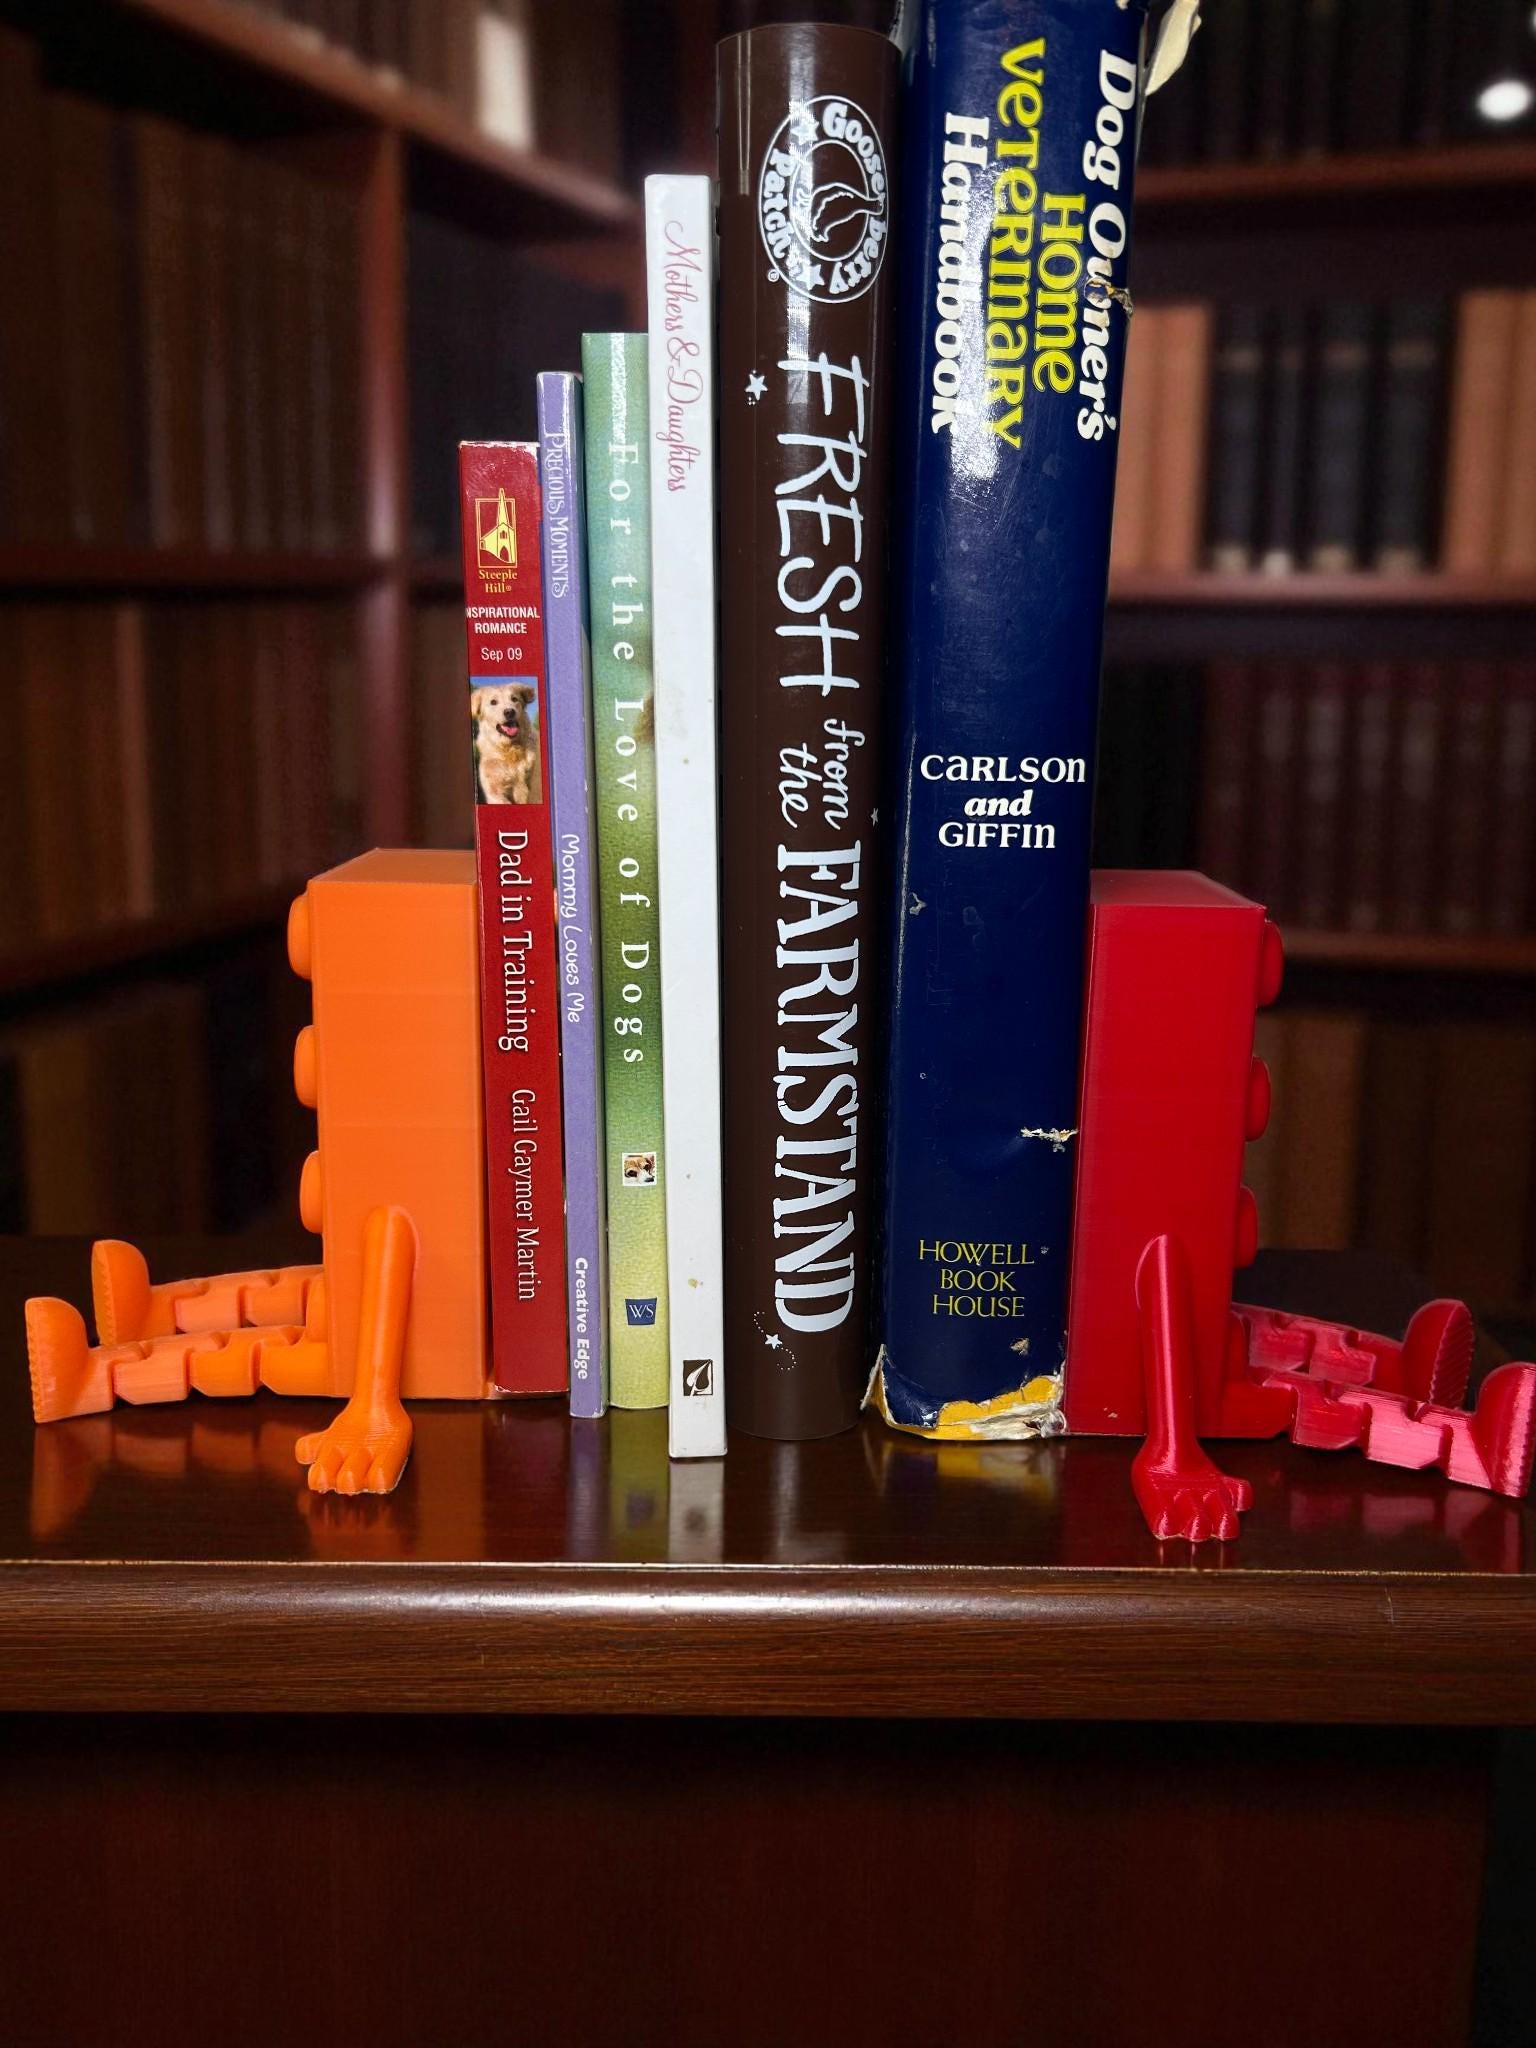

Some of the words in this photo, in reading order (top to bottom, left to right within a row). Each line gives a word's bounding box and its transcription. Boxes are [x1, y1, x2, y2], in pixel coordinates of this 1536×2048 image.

[1082, 49, 1138, 190] Dog
[664, 220, 703, 333] Mothers
[667, 336, 704, 367] &
[656, 366, 704, 493] Daughters
[608, 441, 639, 535] For
[775, 352, 870, 697] FRESH
[478, 569, 518, 583] Steeple
[549, 516, 569, 599] MOMENTS
[474, 622, 528, 634] ROMANCE
[481, 647, 504, 663] Sep
[507, 647, 523, 661] 09
[612, 574, 645, 661] the
[614, 697, 645, 822] Love
[778, 742, 823, 830] the
[823, 718, 866, 831] from
[963, 788, 1035, 817] and
[498, 830, 532, 887] Dad
[560, 833, 581, 919] Mommy
[618, 857, 651, 908] of
[502, 895, 532, 923] in
[498, 930, 536, 1053] Training
[563, 925, 584, 986] Loves
[567, 992, 586, 1023] Me
[614, 941, 650, 1063] Dogs
[512, 1089, 539, 1132] Gail
[772, 840, 862, 1333] FARMSTAND
[508, 1139, 538, 1221] Gaymer
[516, 1226, 541, 1301] Martin
[919, 1239, 1035, 1266] HOWELL
[940, 1268, 1017, 1292] BOOK
[575, 1257, 590, 1334] Creative
[629, 1303, 654, 1318] WS
[932, 1294, 1025, 1317] HOUSE
[573, 1338, 590, 1380] Edge
